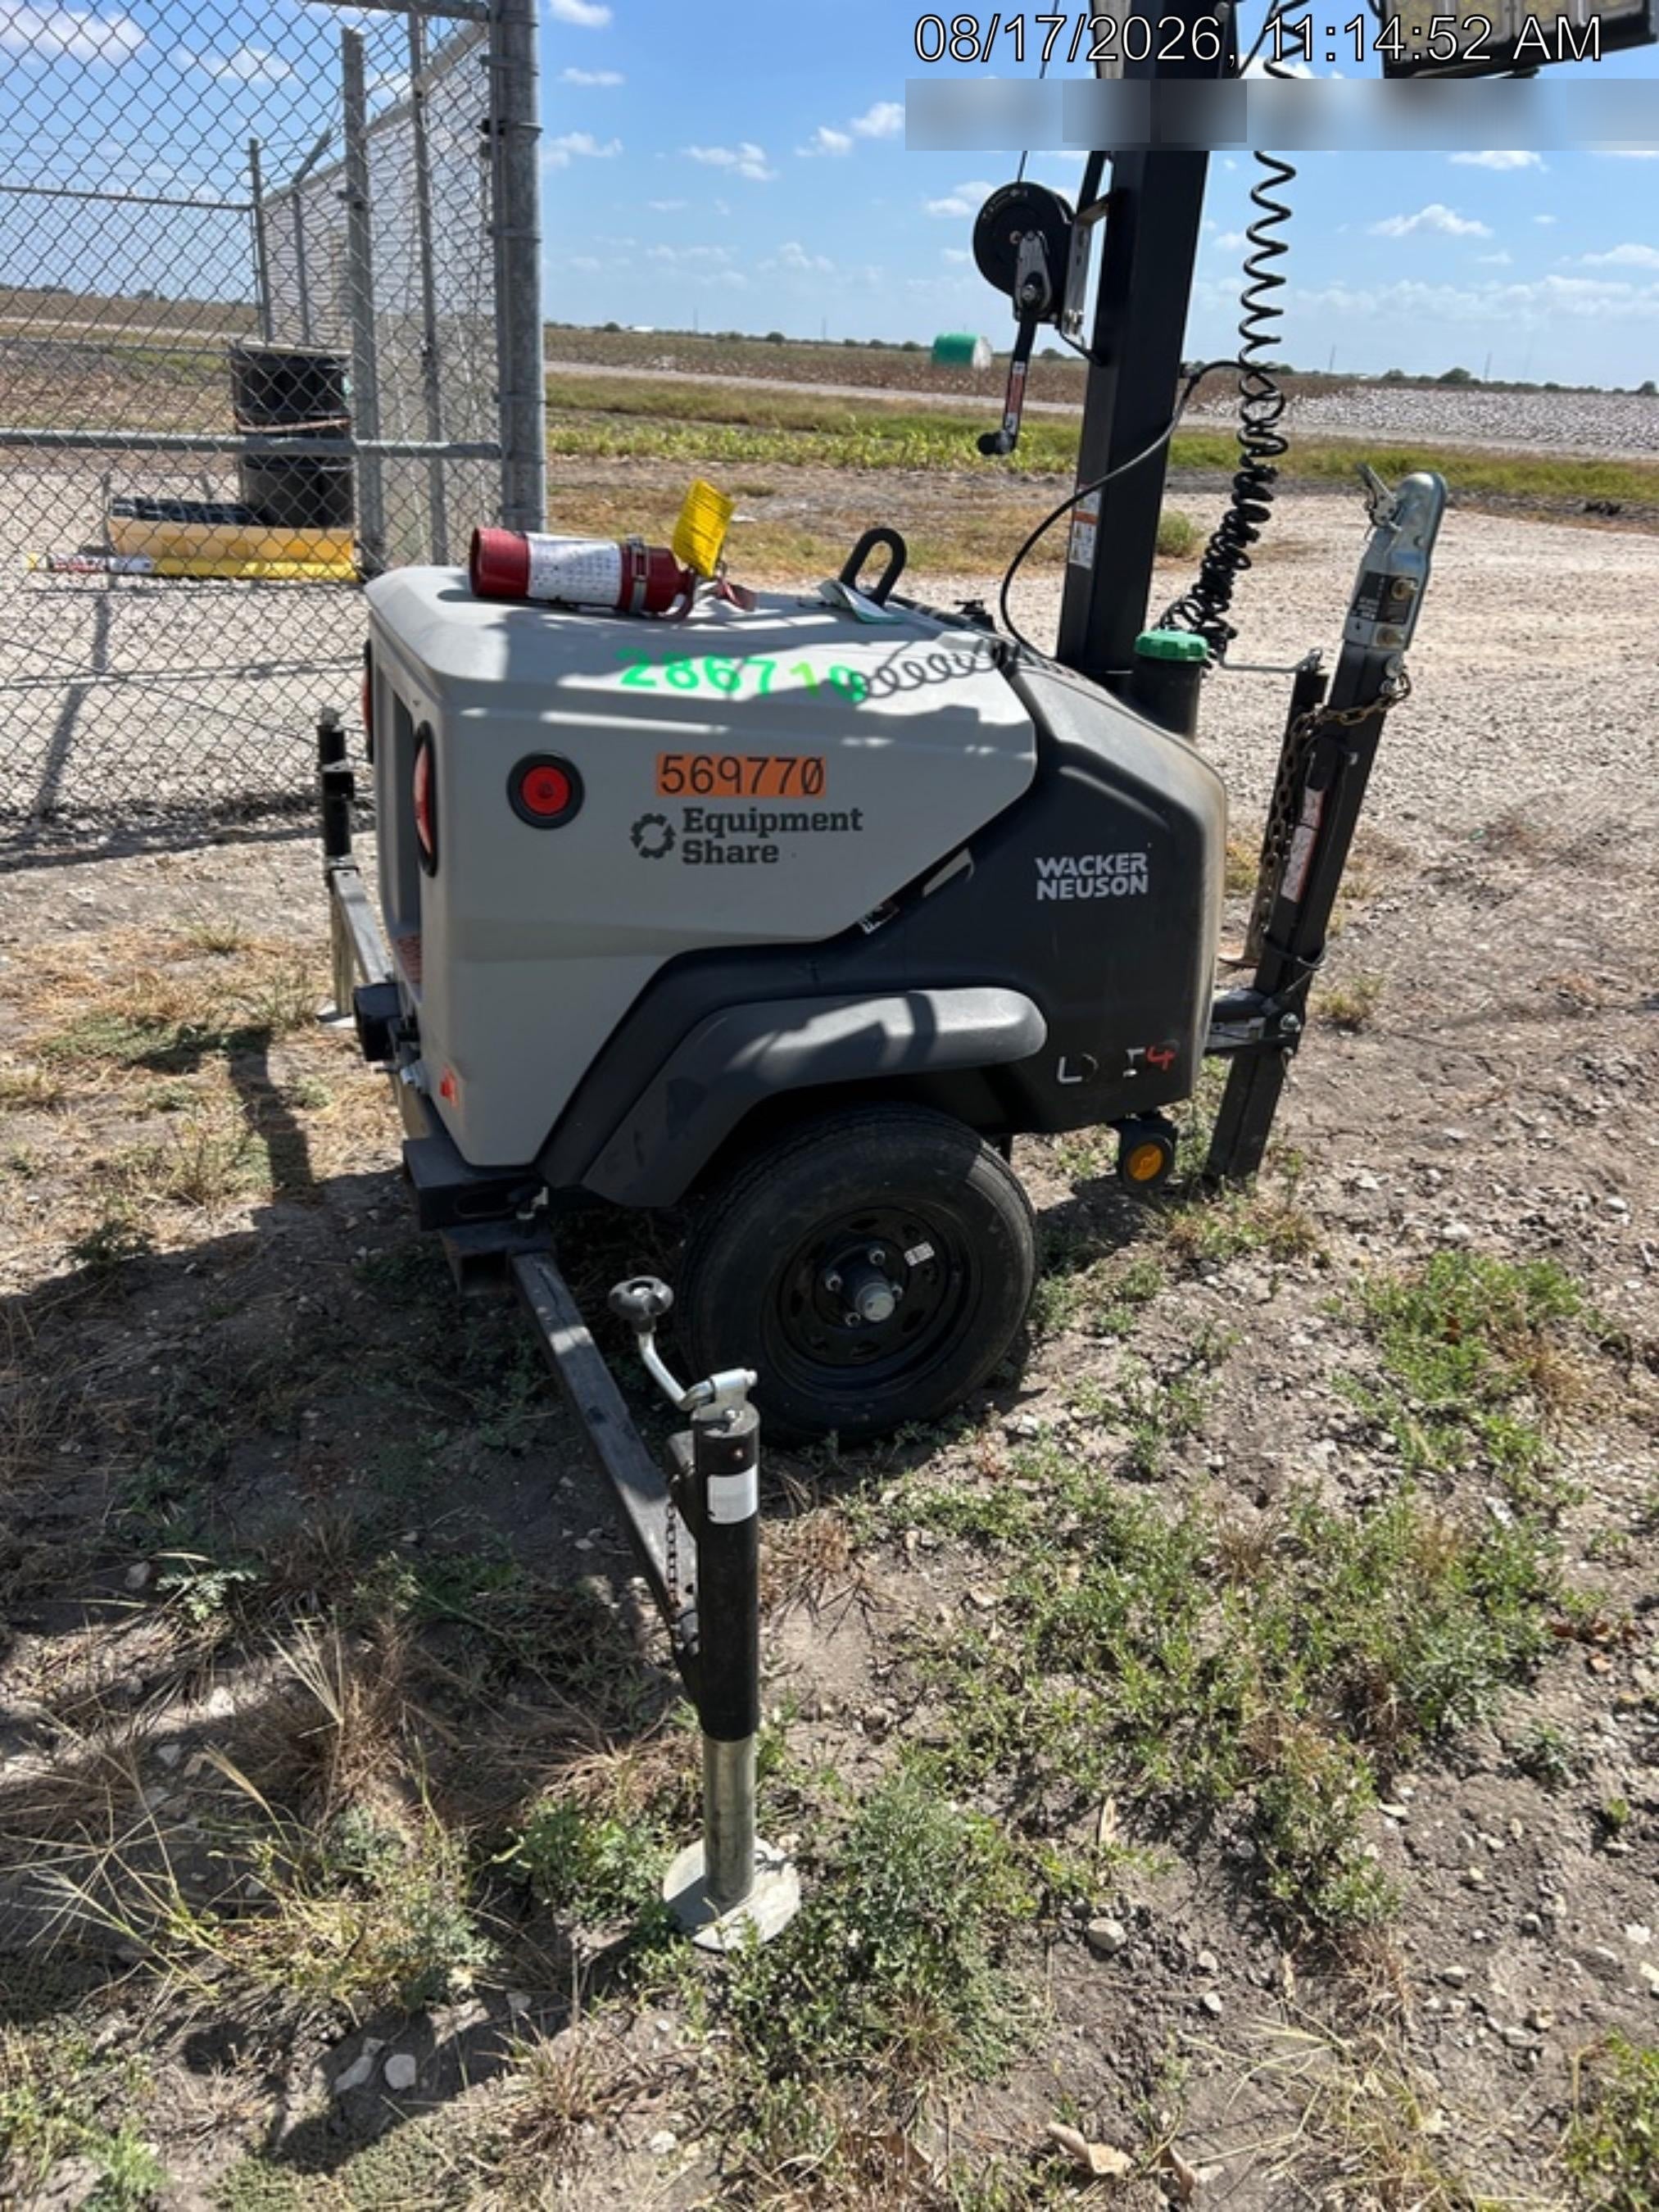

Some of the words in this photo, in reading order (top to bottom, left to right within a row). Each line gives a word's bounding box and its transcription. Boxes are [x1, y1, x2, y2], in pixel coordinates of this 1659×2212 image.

[660, 755, 824, 795] 569770
[682, 805, 863, 838] Equipment
[682, 839, 779, 864] Share
[1035, 851, 1148, 878] WACKER
[1036, 873, 1148, 900] NEUSON
